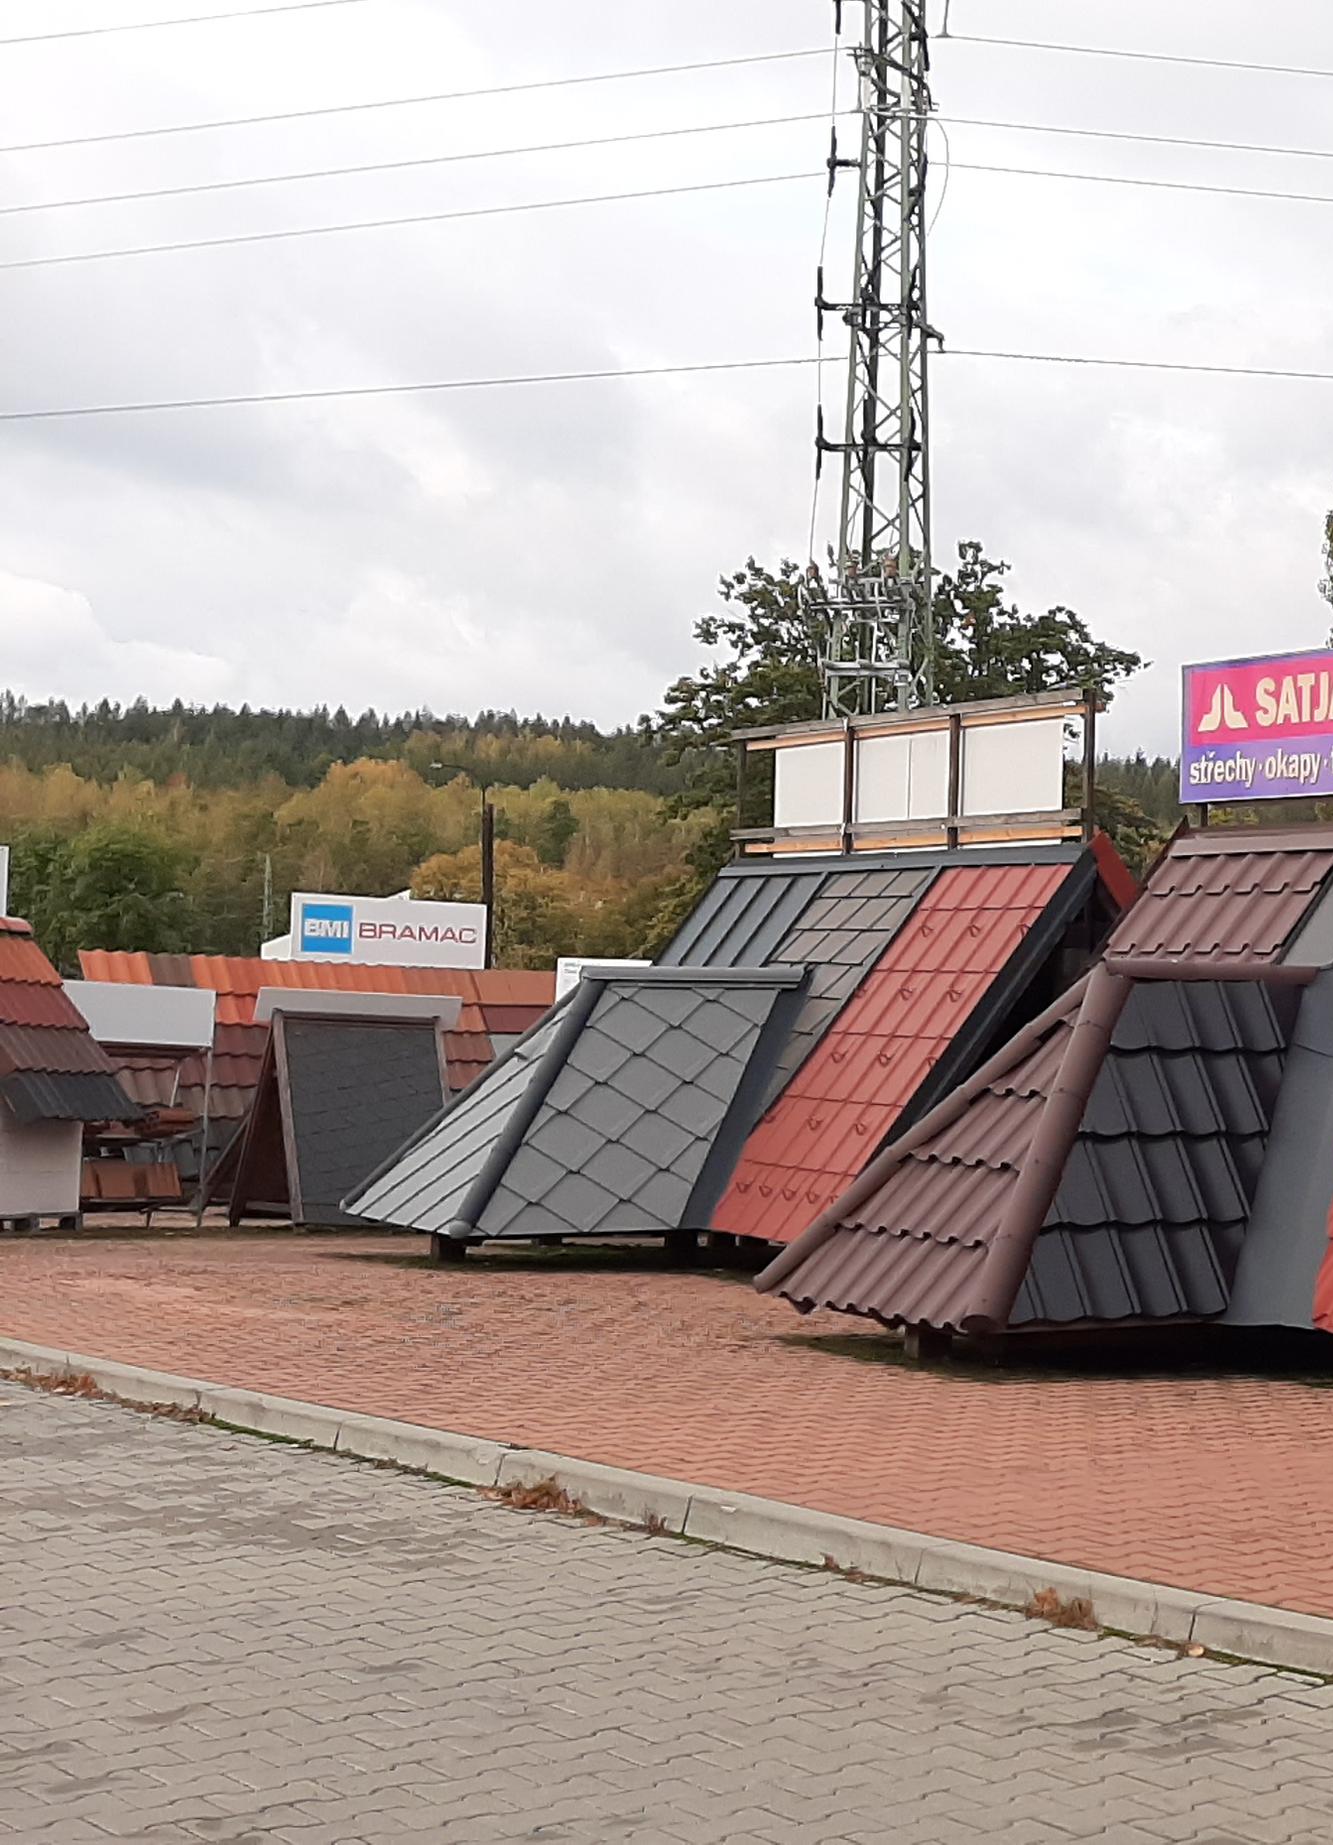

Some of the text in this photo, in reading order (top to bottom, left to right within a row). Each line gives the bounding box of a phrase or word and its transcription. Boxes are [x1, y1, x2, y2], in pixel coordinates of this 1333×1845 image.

[1265, 747, 1321, 784] okapy
[303, 918, 350, 938] BMI
[358, 922, 477, 944] BRAMAC
